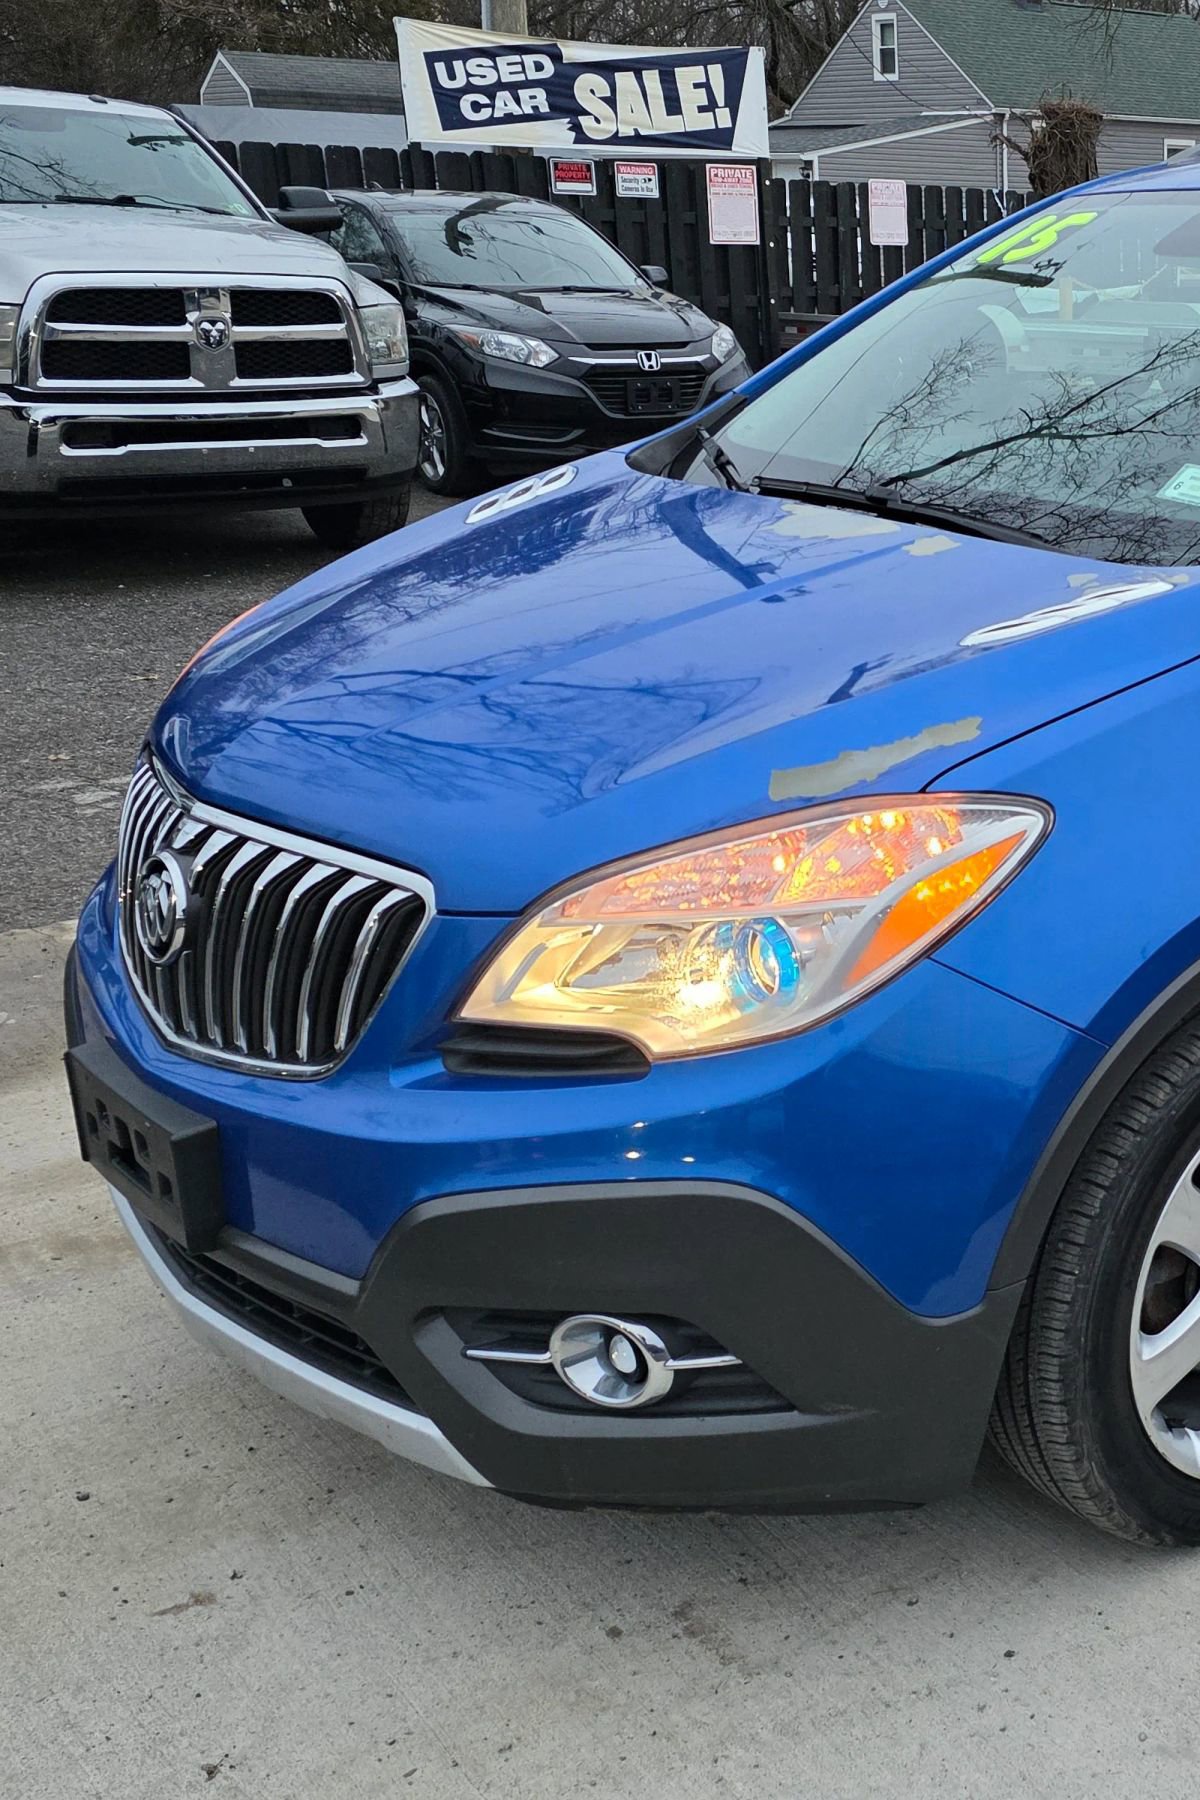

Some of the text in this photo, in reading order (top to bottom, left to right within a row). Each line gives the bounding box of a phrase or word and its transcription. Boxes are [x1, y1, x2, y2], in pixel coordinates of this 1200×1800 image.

[434, 54, 555, 89] USED
[460, 88, 550, 121] CAR
[573, 64, 733, 140] SALE!
[557, 163, 587, 171] PRIVATE
[619, 165, 654, 175] WARNING
[555, 170, 590, 179] PROPERTY
[710, 168, 753, 178] PRIVATE
